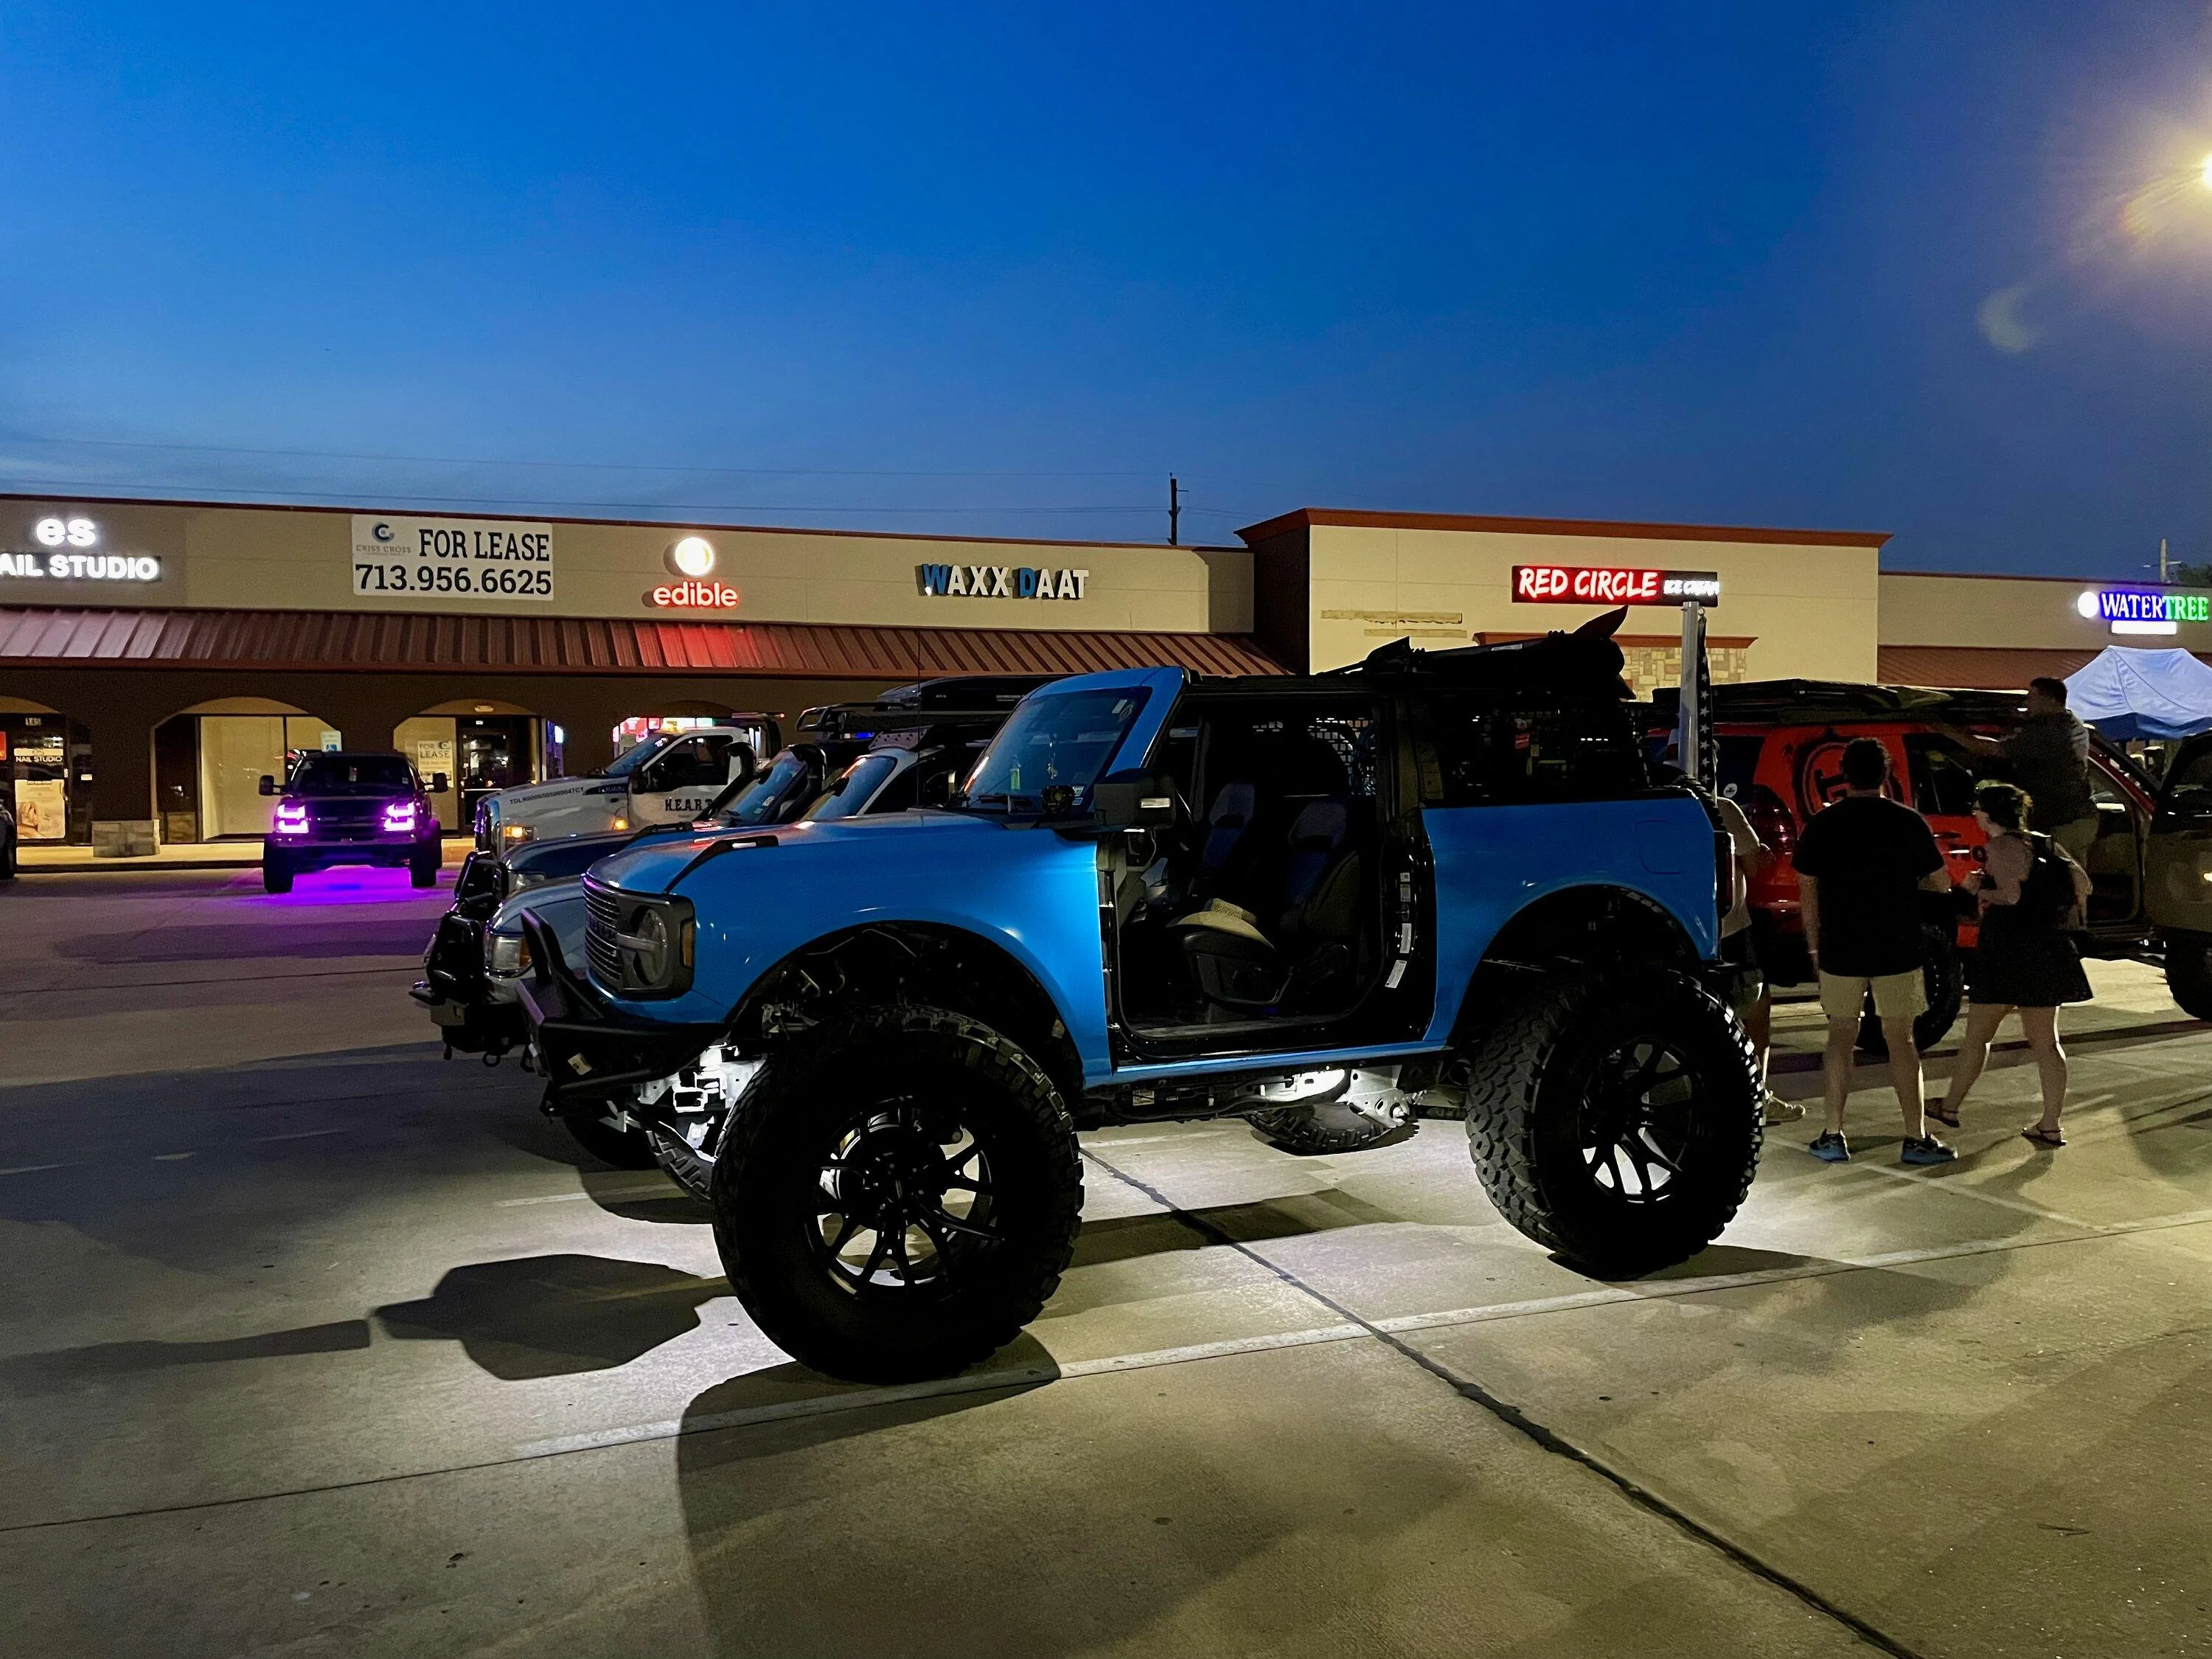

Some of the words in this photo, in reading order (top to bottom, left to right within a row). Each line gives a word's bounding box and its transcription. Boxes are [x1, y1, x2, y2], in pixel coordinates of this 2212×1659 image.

[36, 518, 97, 547] es
[418, 528, 467, 558] FOR
[473, 531, 550, 562] LEASE
[383, 546, 412, 554] CROSS
[49, 554, 159, 580] STUDIO
[355, 563, 552, 595] 713.956.6625
[922, 563, 1010, 597] WAXX
[1019, 567, 1090, 599] DAAT
[653, 580, 738, 607] edible
[1518, 567, 1569, 599] RED
[1573, 570, 1659, 601] CIRCLE
[420, 751, 451, 759] LEASE
